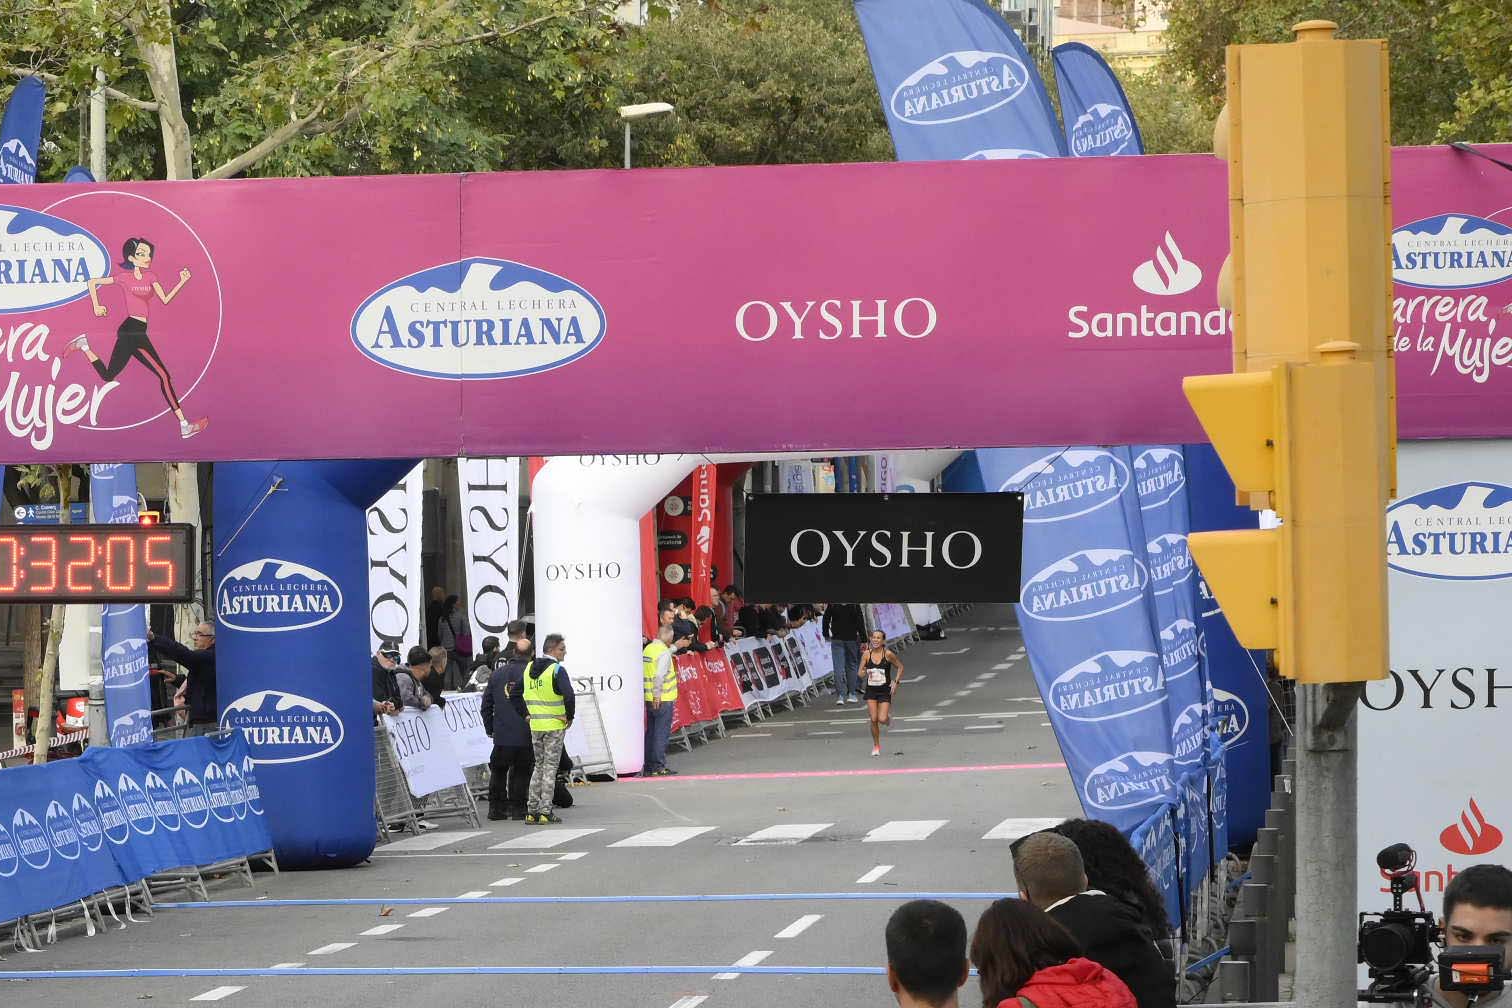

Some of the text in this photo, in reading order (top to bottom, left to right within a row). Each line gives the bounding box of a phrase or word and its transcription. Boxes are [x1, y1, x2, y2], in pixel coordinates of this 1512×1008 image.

[11, 241, 85, 252] LECHERA
[1407, 240, 1459, 249] CENTRAL
[410, 298, 577, 313] CENTRAL LECHERA
[1393, 294, 1489, 324] arrera
[370, 305, 586, 349] ASTURIANA
[734, 297, 937, 341] OYSHO
[1417, 324, 1434, 352] la
[1414, 517, 1481, 527] CENTRAL
[790, 529, 982, 569] OYSHO
[546, 562, 621, 582] OYSHO
[233, 583, 328, 592] CENTRAL LECHERA
[220, 588, 333, 616] ASTURIANA
[576, 674, 623, 692] SHO
[235, 715, 329, 724] CENTRAL LECHERA
